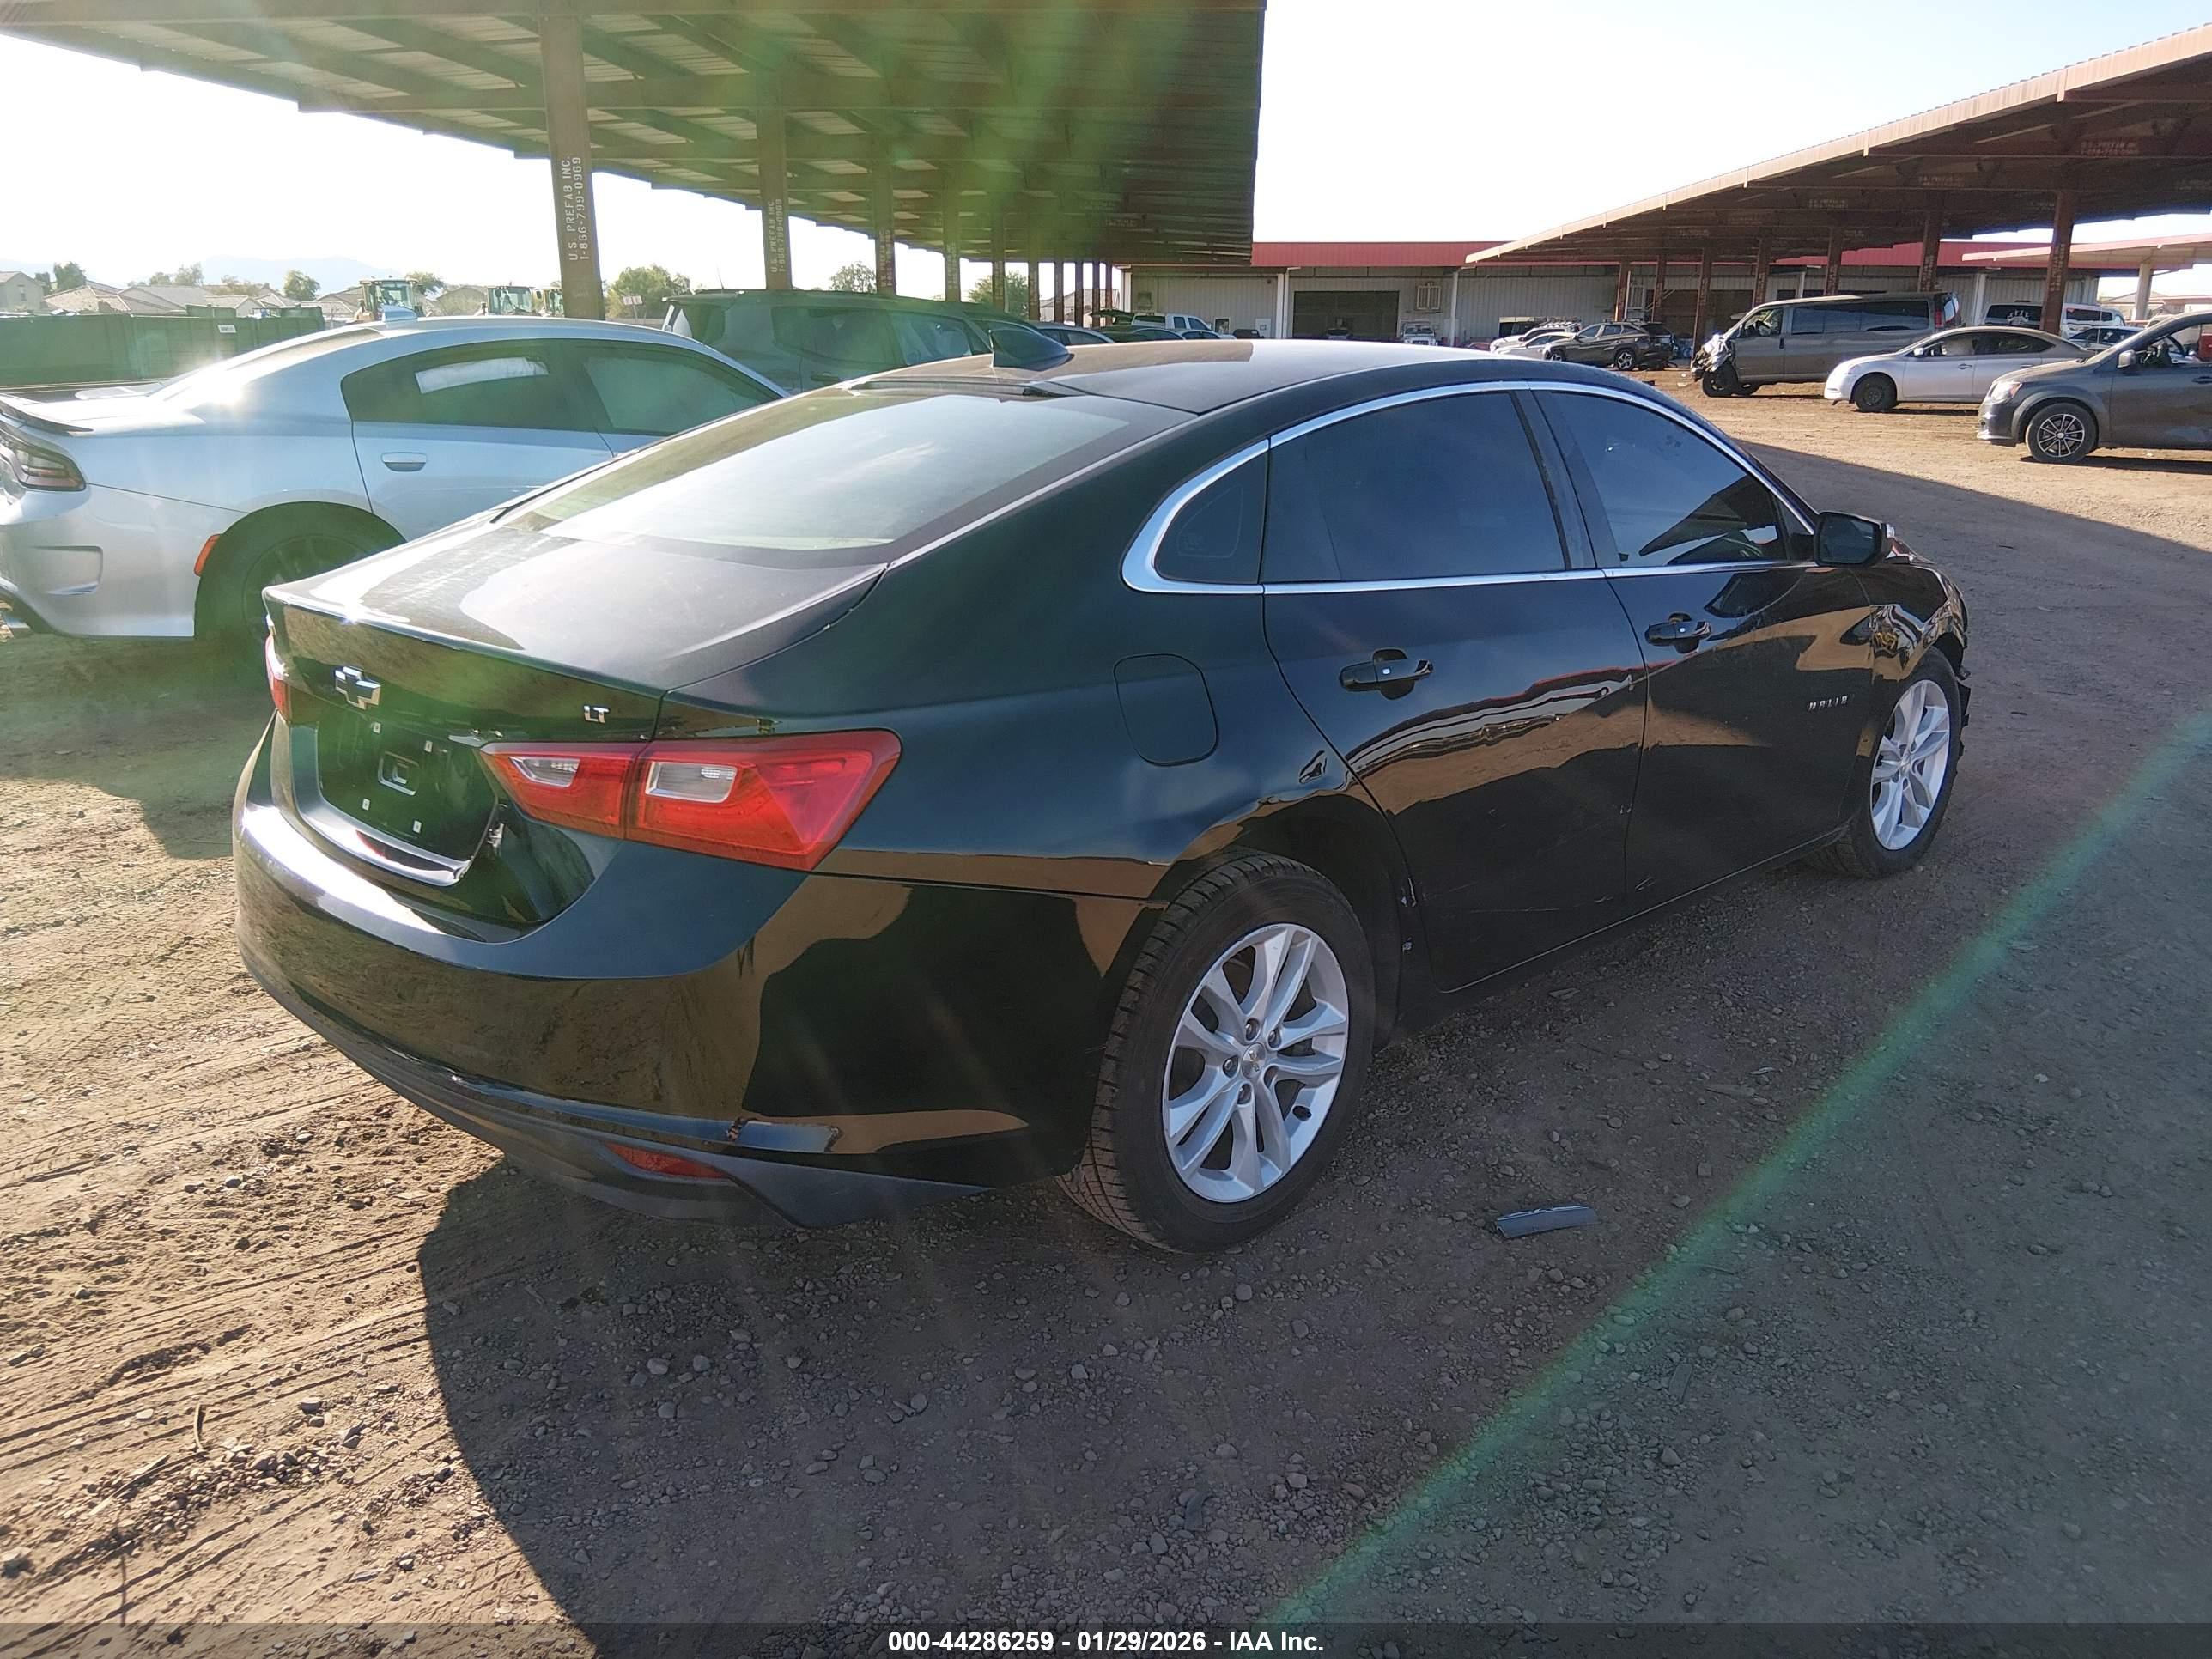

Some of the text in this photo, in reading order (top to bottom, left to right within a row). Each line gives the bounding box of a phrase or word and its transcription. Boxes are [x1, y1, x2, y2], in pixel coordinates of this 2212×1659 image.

[561, 156, 572, 179] INC.
[563, 185, 576, 232] PREFAB
[583, 705, 609, 724] LT
